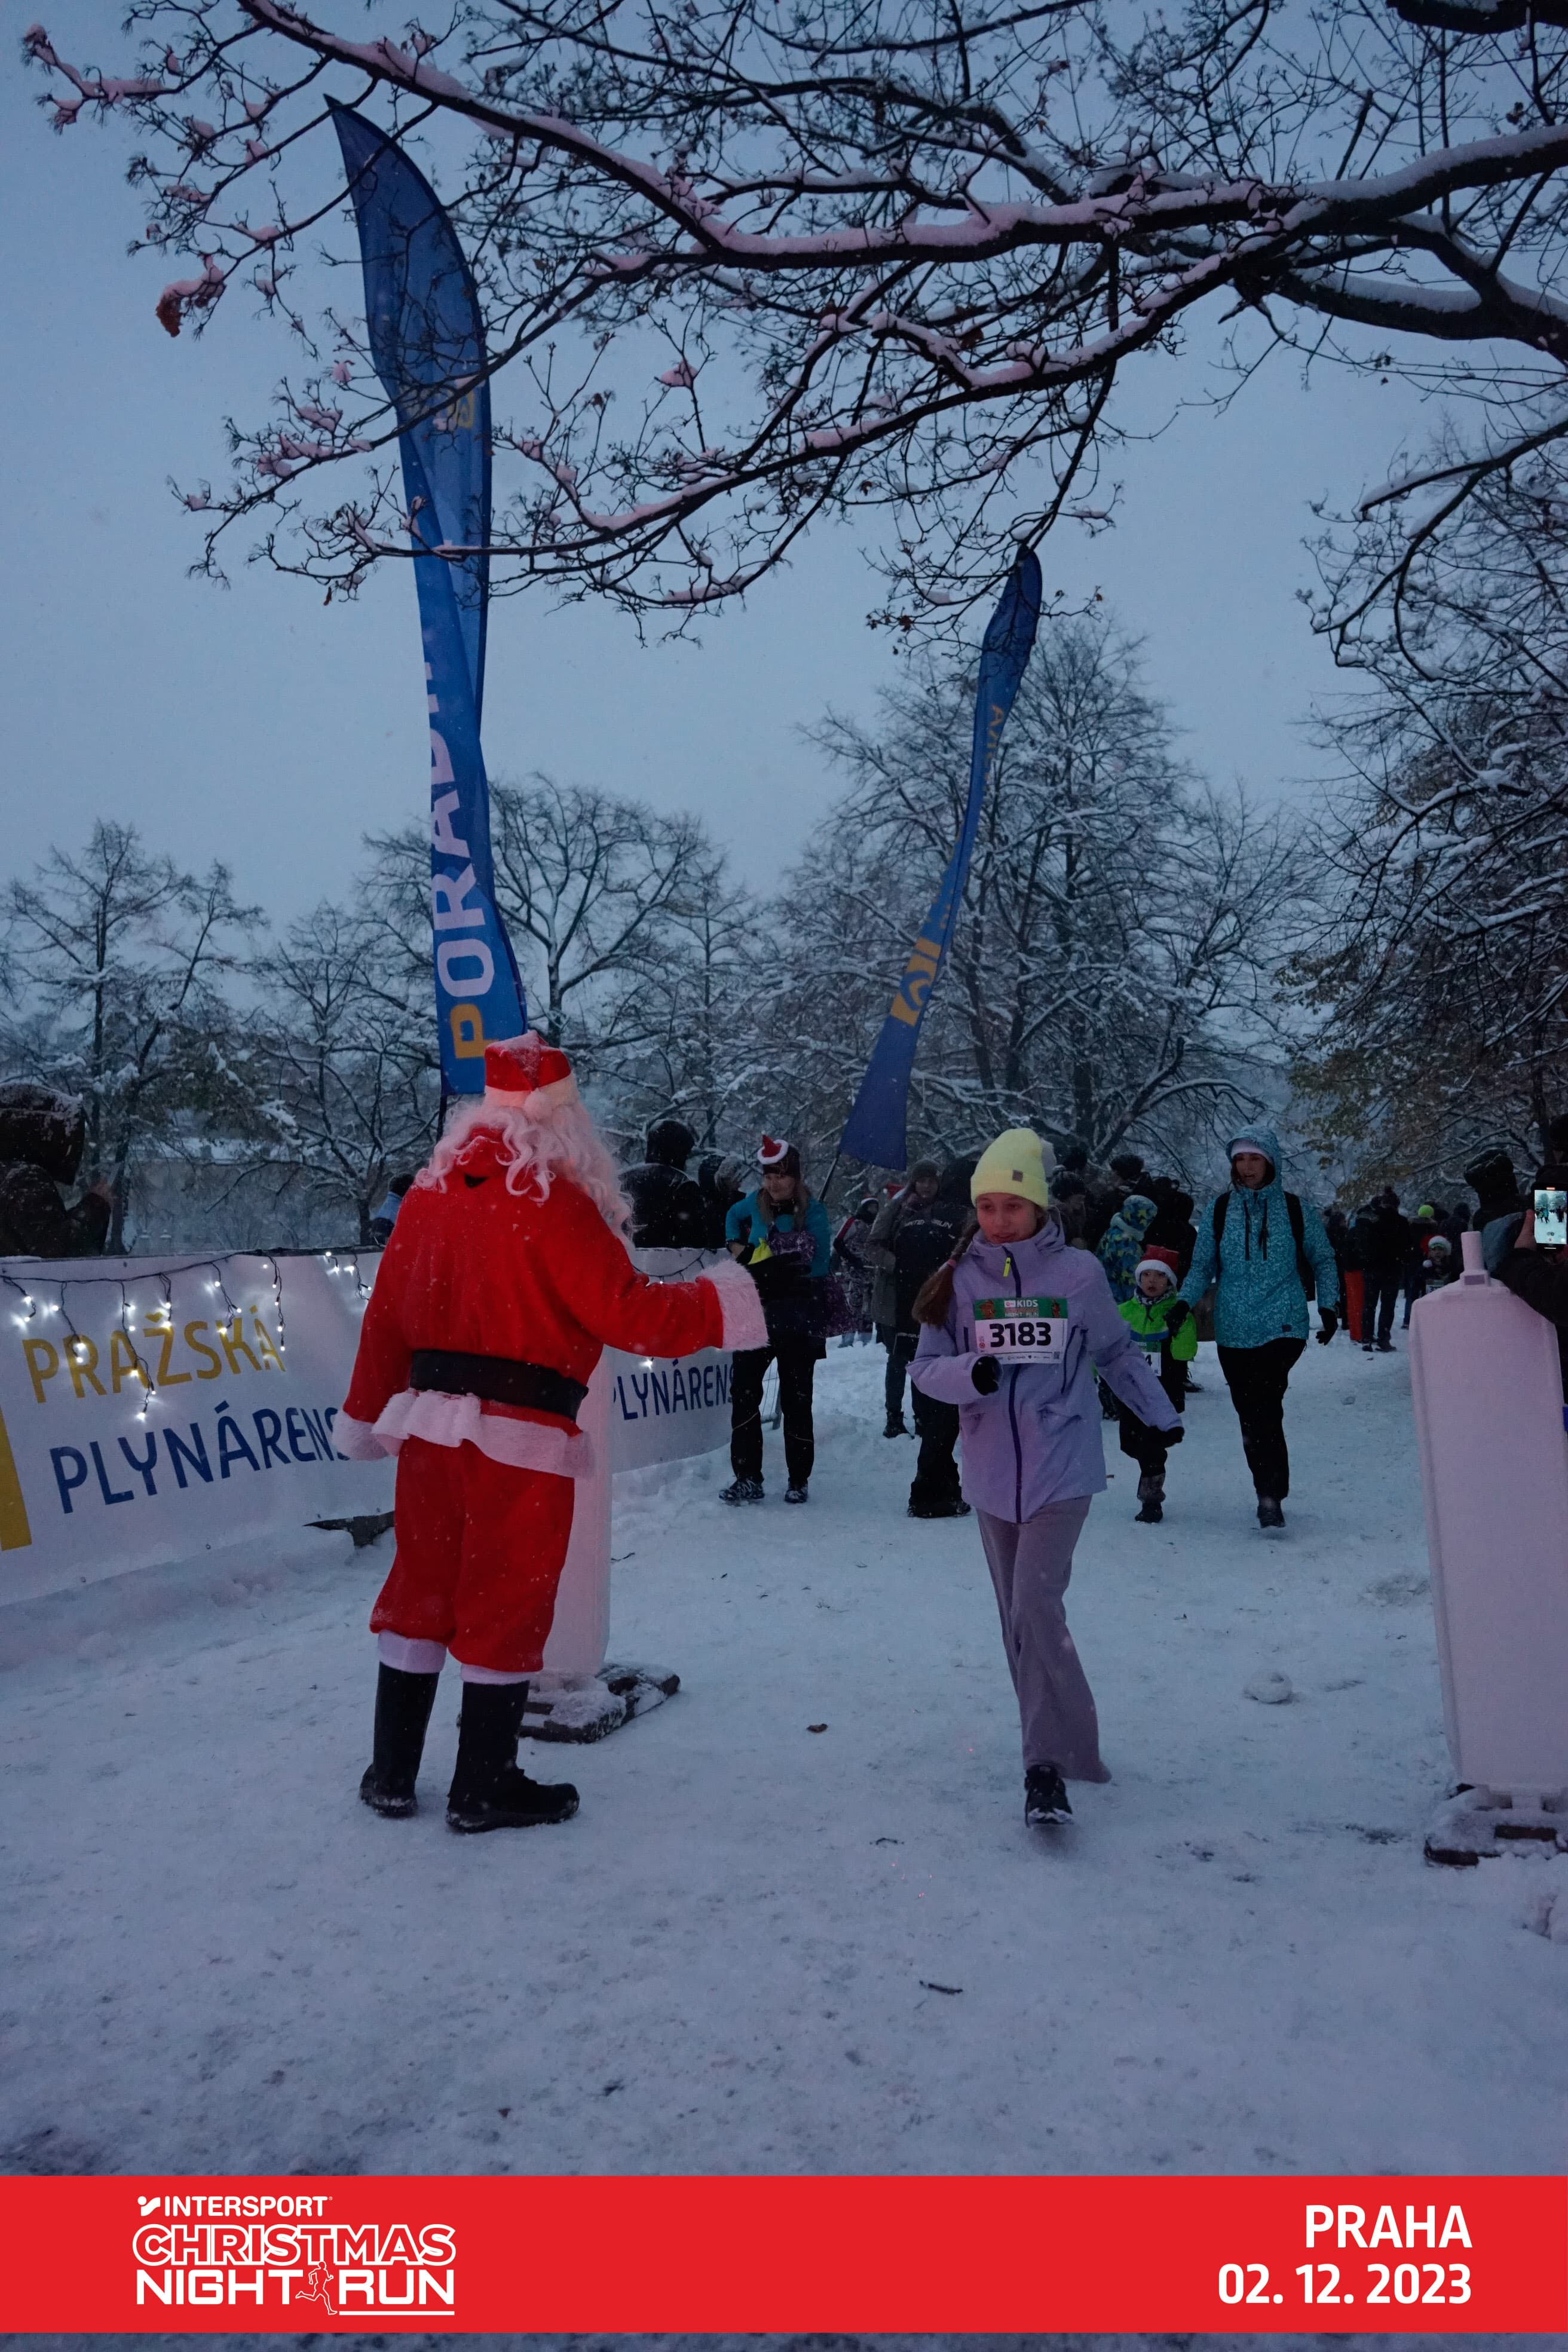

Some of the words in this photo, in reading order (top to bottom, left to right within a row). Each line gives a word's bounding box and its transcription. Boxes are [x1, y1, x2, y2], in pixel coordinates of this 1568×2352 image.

[1016, 1299, 1039, 1307] KIDS
[989, 1322, 1052, 1348] 3183
[22, 1306, 285, 1403] PRAŽSKÁ
